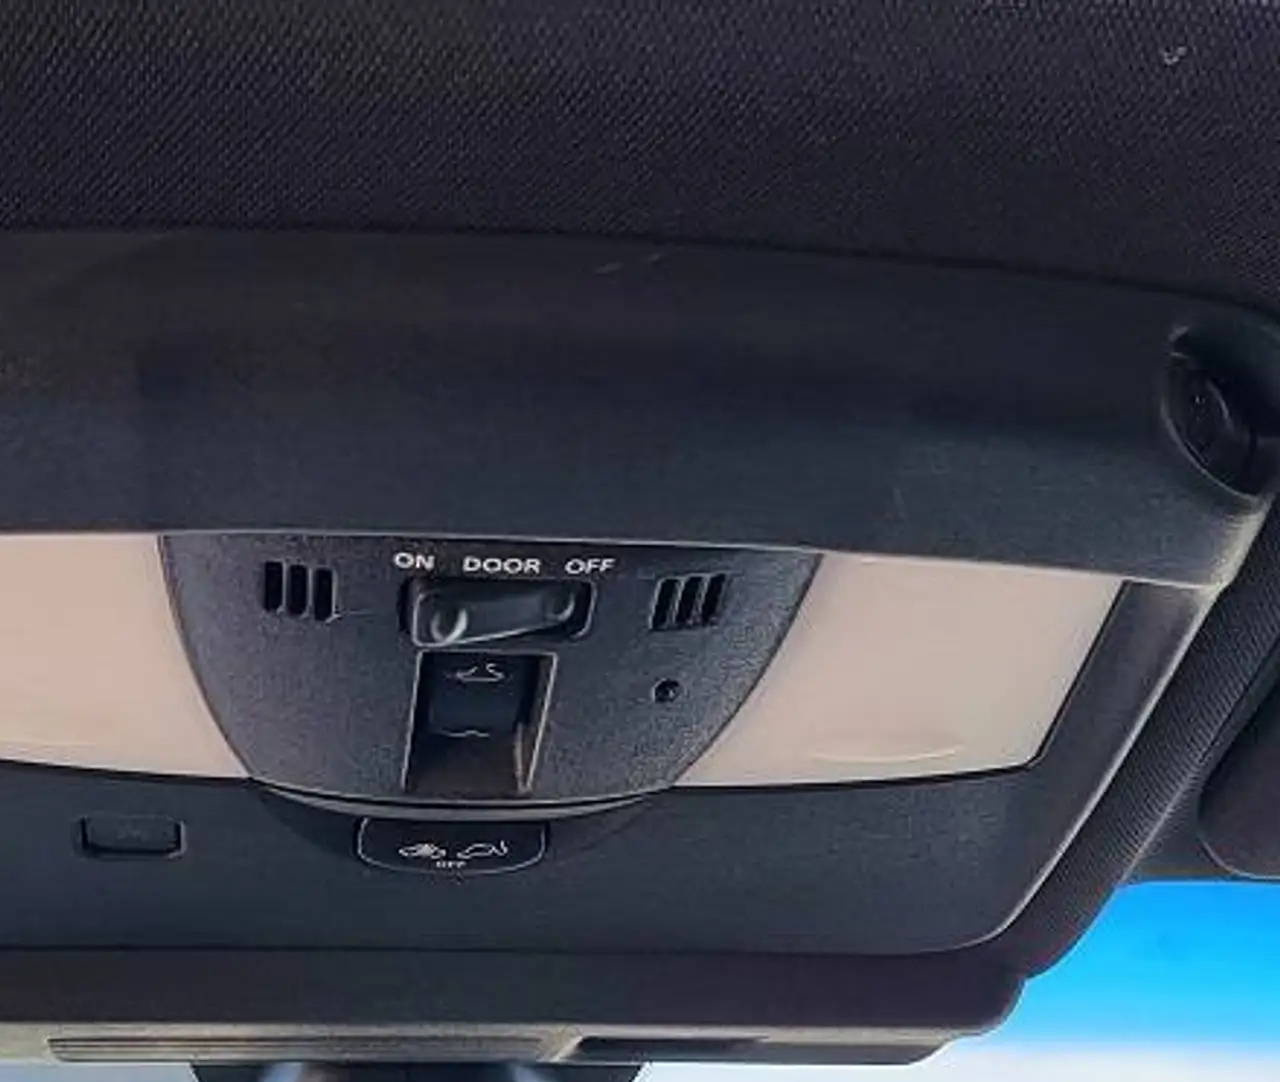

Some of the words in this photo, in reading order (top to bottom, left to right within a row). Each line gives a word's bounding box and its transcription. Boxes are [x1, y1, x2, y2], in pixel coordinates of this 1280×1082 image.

[394, 552, 435, 569] ON
[463, 555, 541, 574] DOOR
[564, 557, 616, 575] OFF
